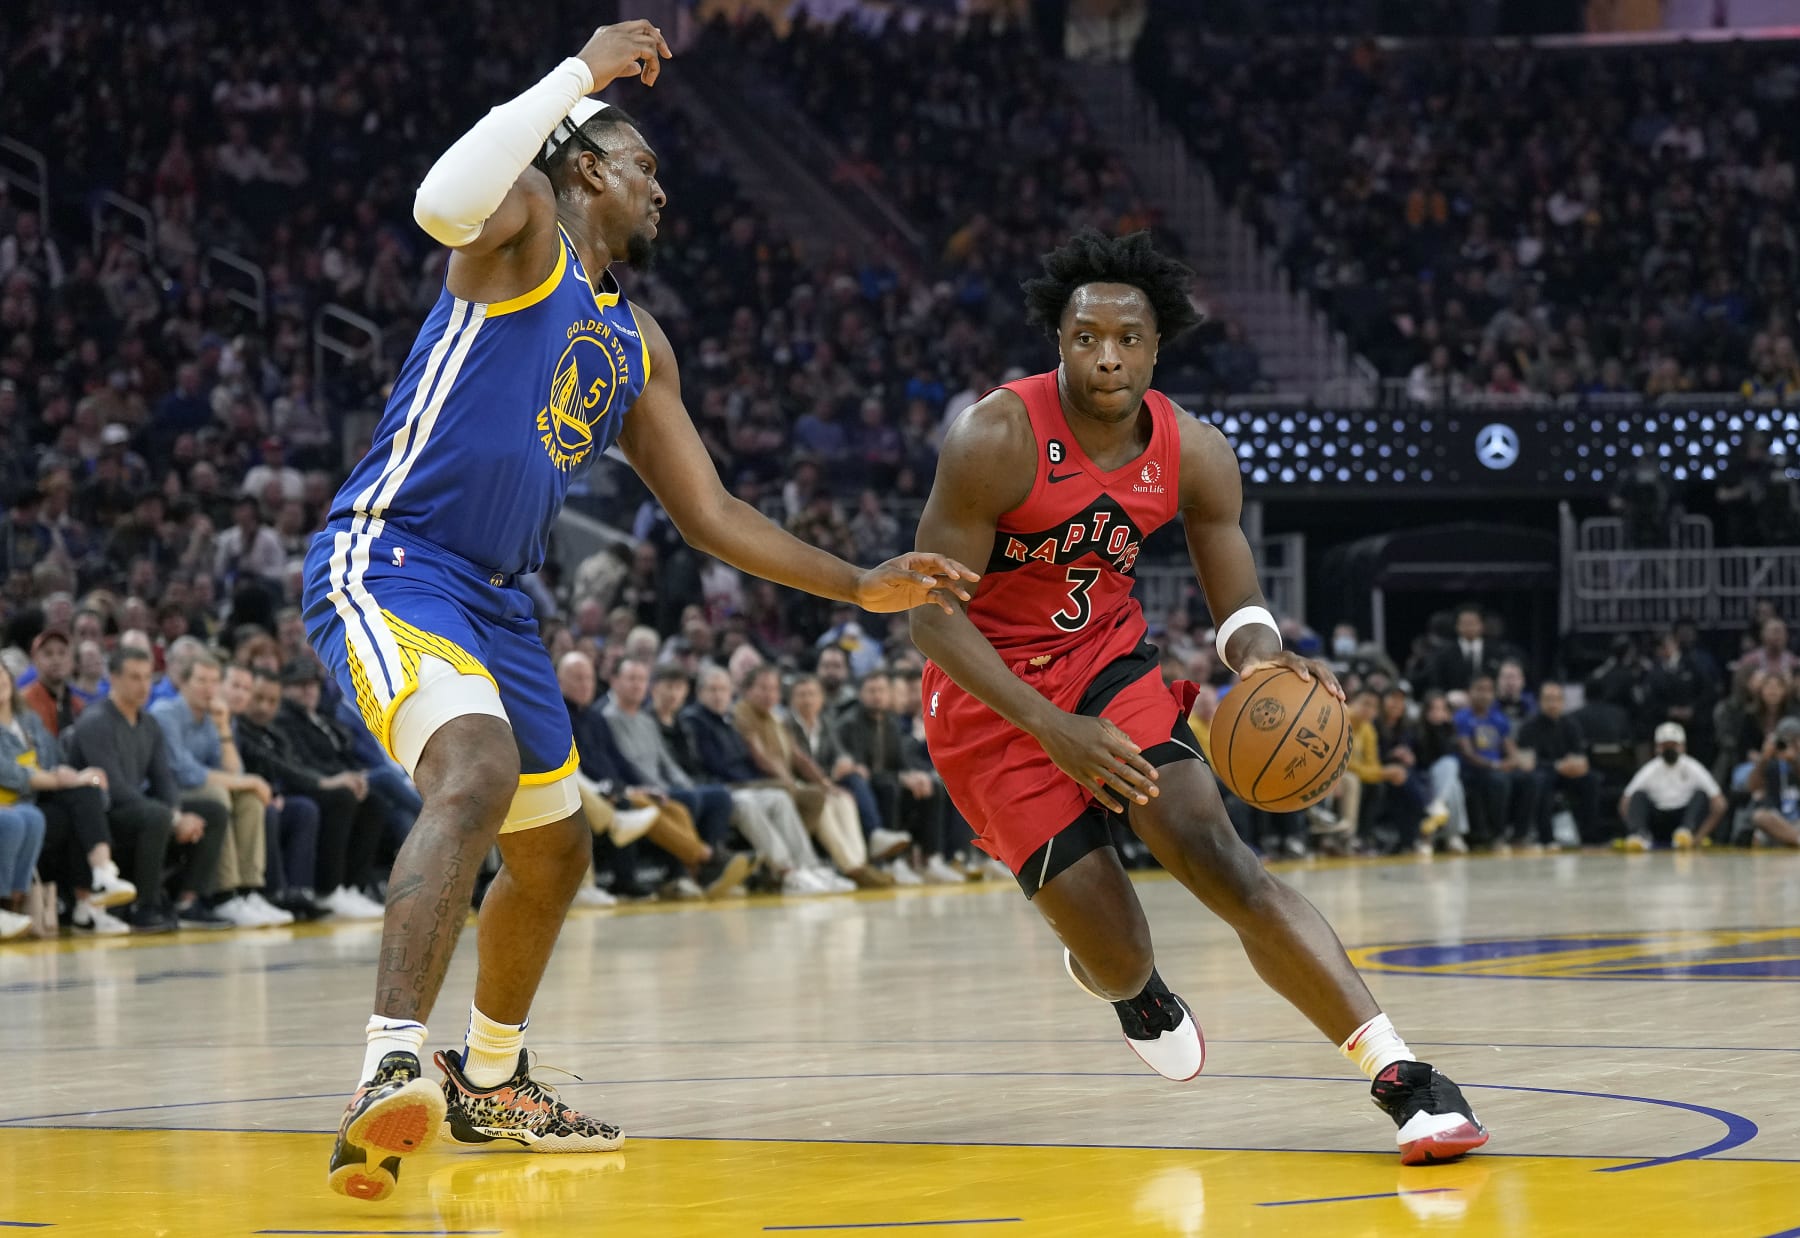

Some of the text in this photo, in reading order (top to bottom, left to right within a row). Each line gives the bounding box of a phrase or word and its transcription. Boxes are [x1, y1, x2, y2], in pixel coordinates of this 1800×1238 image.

[567, 319, 629, 385] GOLDEN STATE
[583, 377, 607, 409] 5
[1049, 442, 1061, 462] 6
[1132, 483, 1165, 494] Sun Life
[1050, 567, 1101, 632] 3
